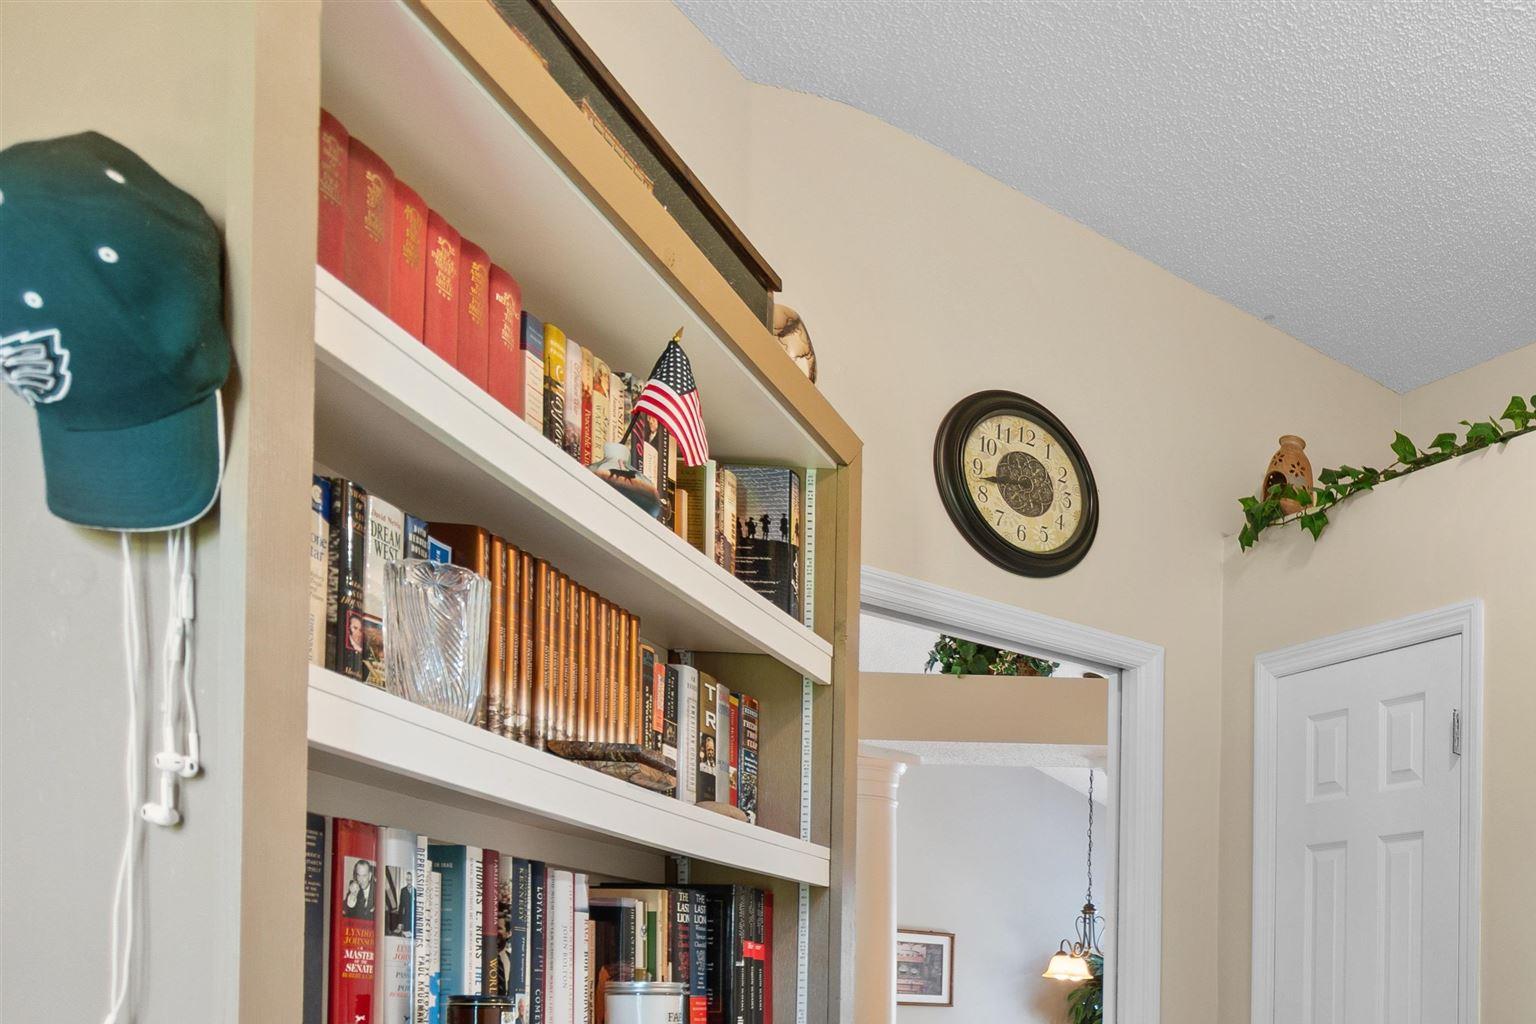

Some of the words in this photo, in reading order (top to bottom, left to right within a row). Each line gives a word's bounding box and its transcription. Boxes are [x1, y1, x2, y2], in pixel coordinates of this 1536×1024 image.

[997, 424, 1011, 444] 11
[1019, 426, 1036, 447] 12
[980, 435, 998, 456] 10
[1045, 443, 1051, 459] 1
[972, 457, 983, 475] 9
[1058, 466, 1067, 483] 2
[977, 486, 989, 503] 8
[1061, 492, 1072, 508] 3
[995, 509, 1005, 526] 7
[1054, 514, 1064, 530] 4
[370, 520, 401, 549] DREAM
[1016, 524, 1027, 542] 6
[1040, 525, 1049, 542] 5
[374, 540, 399, 561] WEST
[416, 848, 425, 898] DEPRESSION
[475, 860, 483, 904] THOMAS
[695, 894, 705, 904] THE
[694, 904, 706, 914] LAST
[416, 901, 424, 948] ECONOMICS
[694, 914, 707, 924] LION
[344, 927, 374, 937] LYNDO
[344, 936, 374, 945] JOHNSO
[475, 926, 483, 958] RICKS
[344, 950, 375, 960] MASTER
[345, 963, 374, 974] SENATE
[488, 958, 498, 993] WORL
